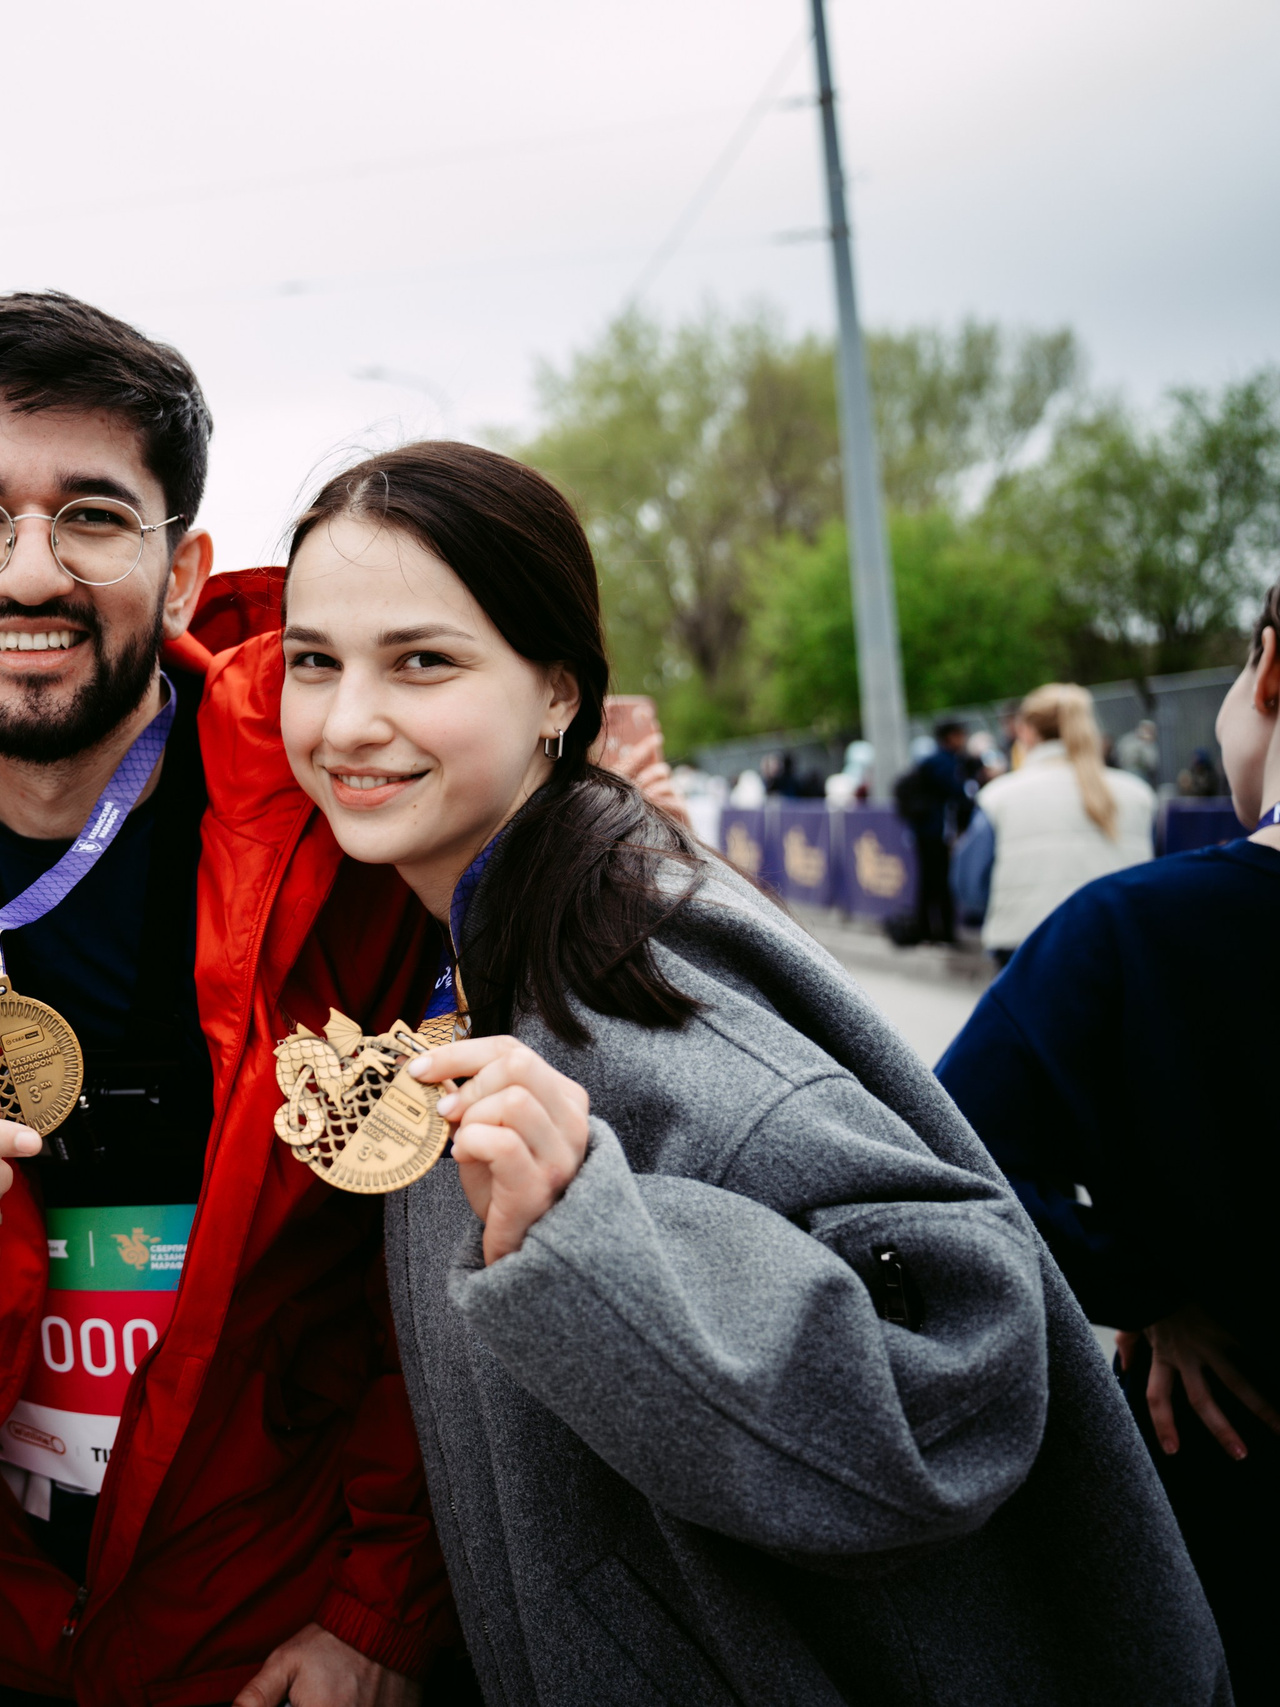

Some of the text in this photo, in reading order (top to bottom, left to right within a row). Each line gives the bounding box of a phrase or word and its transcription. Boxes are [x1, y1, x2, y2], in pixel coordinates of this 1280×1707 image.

[88, 801, 114, 839] КАЗАНСКИЙ
[98, 808, 120, 838] МАРАФОН
[9, 1045, 61, 1067] КАЗАНСКИЙ
[12, 1057, 53, 1075] МАРАФОН
[15, 1071, 36, 1084] 2025
[29, 1085, 42, 1103] 3
[362, 1123, 385, 1142] 2025
[368, 1117, 408, 1148] МАРАФОН
[373, 1108, 422, 1148] КАЗАНСКИЙ
[357, 1142, 374, 1162] 3
